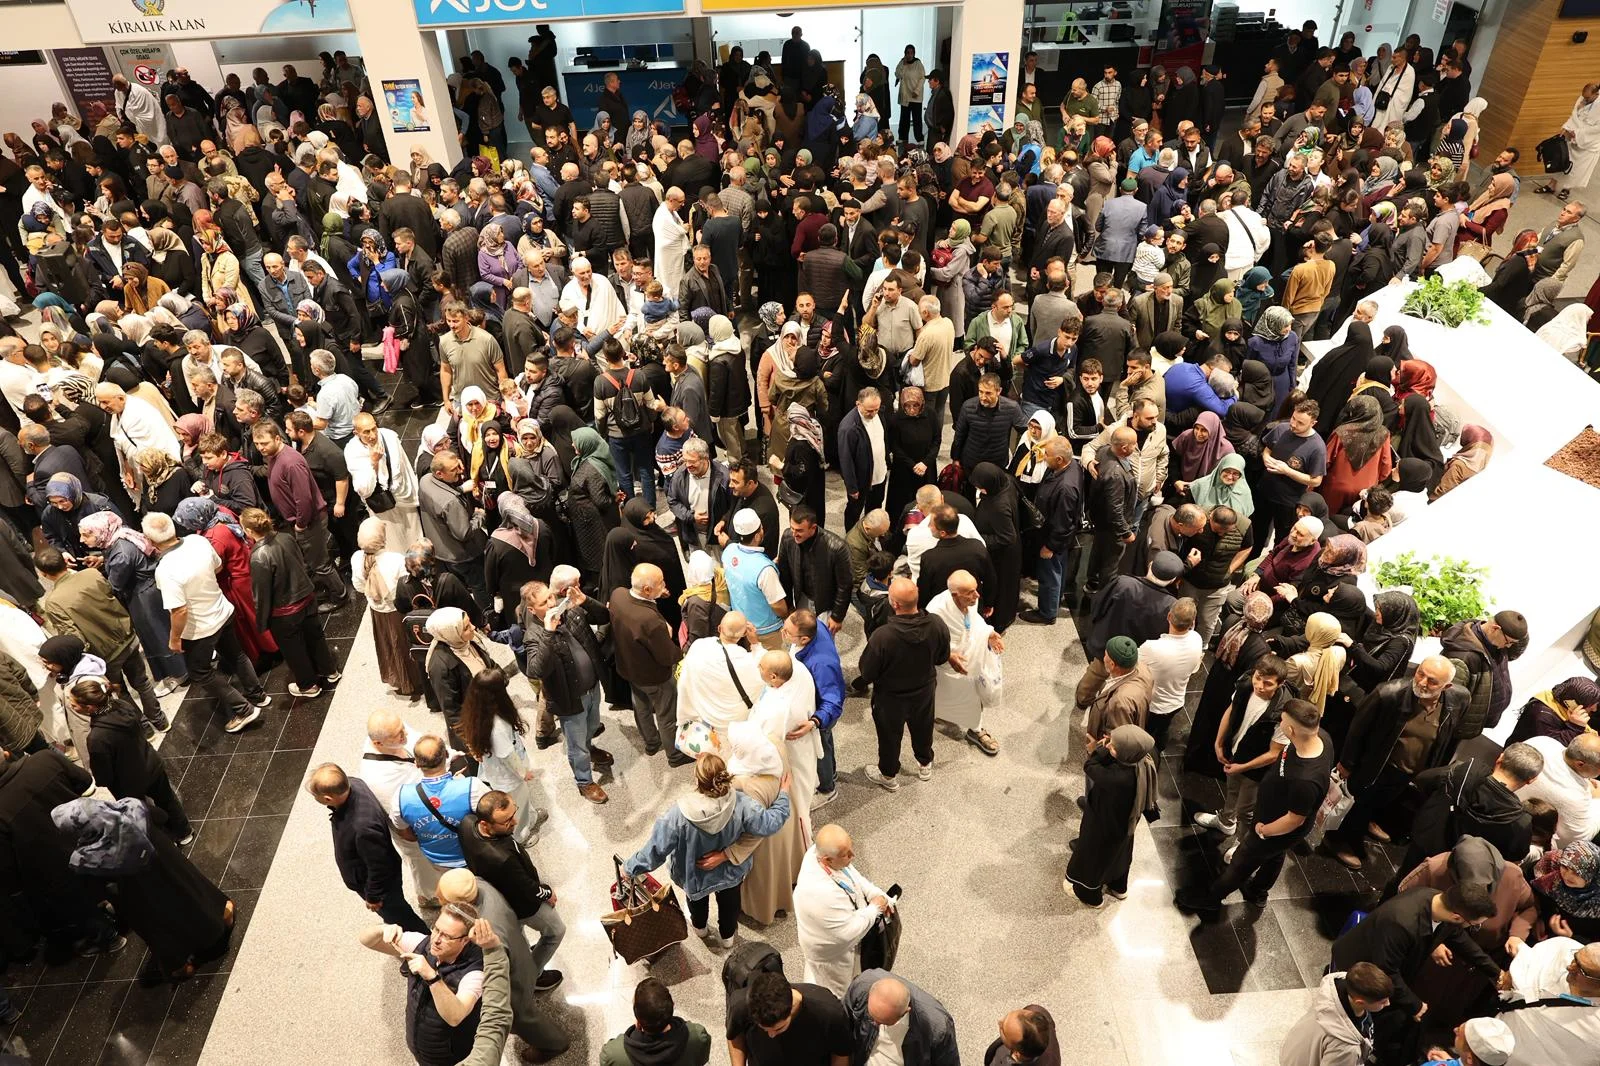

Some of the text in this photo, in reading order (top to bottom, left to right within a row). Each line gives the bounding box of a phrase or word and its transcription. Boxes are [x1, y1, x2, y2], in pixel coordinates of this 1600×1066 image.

[108, 18, 206, 34] KİRALIK ALAN
[584, 83, 605, 93] AJe
[648, 79, 676, 89] AJet
[414, 815, 460, 829] DİYAET
